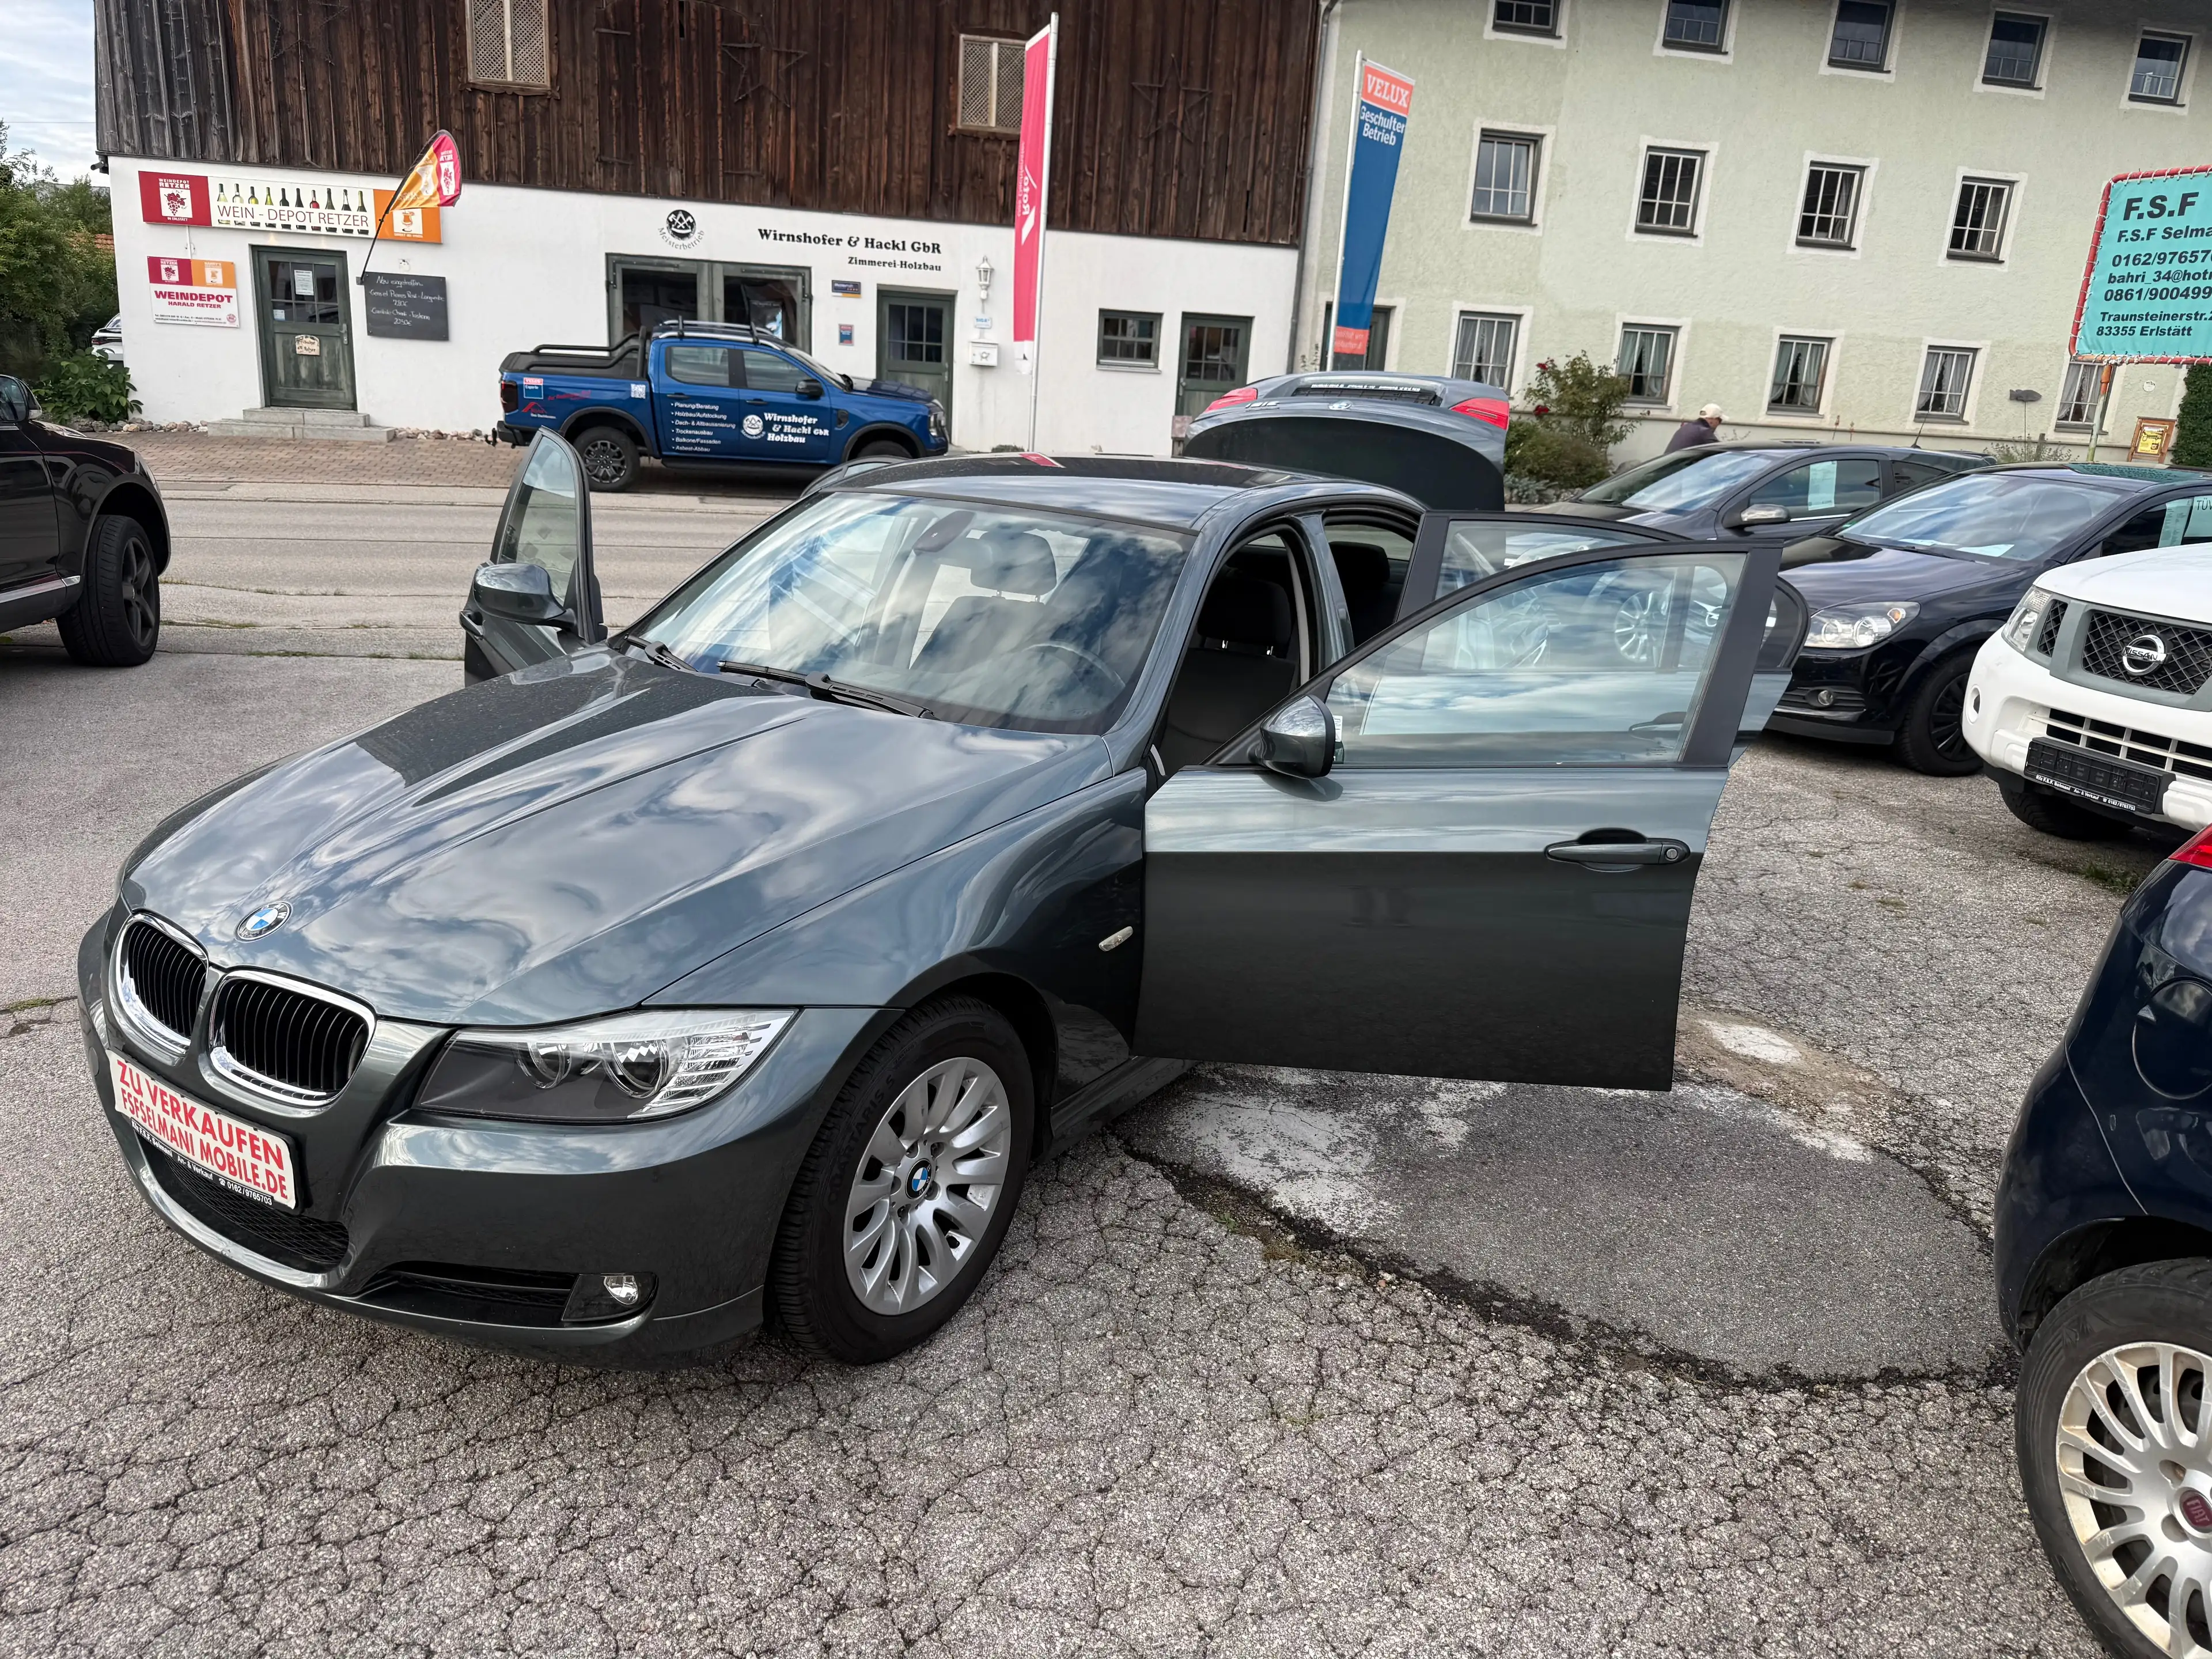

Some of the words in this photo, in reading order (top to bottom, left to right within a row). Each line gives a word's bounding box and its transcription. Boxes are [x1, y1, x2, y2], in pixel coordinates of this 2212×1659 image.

[1367, 74, 1409, 108] VELUX
[1360, 105, 1406, 134] Geschulter
[1362, 123, 1396, 146] Betrieb
[2123, 192, 2199, 221] F.S.F
[218, 205, 254, 219] WEIN
[268, 209, 314, 223] DEPOT
[319, 213, 369, 227] RETZER
[658, 228, 704, 250] Meisterbetrieb
[758, 229, 843, 246] Wirnshofer
[848, 236, 859, 247] &
[865, 237, 906, 251] Hackl
[911, 241, 941, 254] GbR
[2117, 228, 2157, 243] F.S.F
[848, 257, 941, 271] Zimmerei-Holzbau
[2112, 249, 2212, 267] 0162/97657
[154, 291, 233, 303] WEINDEPOT
[2104, 286, 2212, 301] 0861/900499
[2096, 326, 2137, 336] 83355
[2139, 325, 2192, 336] Erlstätt
[675, 402, 719, 411] Planung/Beratung
[675, 411, 727, 420] Holzbau/Aufstockung
[764, 412, 817, 425] Wirnshofer
[772, 424, 781, 432] &
[783, 425, 811, 434] Hackl
[767, 433, 806, 443] Holzbau
[2122, 647, 2158, 661] NISSAN
[2085, 790, 2100, 800] Verkauf
[117, 1060, 142, 1095] ZU
[145, 1078, 284, 1171] VERKAUFEN
[121, 1088, 195, 1156] FSFSELMANI
[200, 1138, 288, 1200] MOBILE.DE
[152, 1138, 173, 1157] Selmani
[177, 1156, 186, 1165] An-
[192, 1164, 213, 1180] Verkauf
[2187, 1499, 2210, 1523] FIAT
